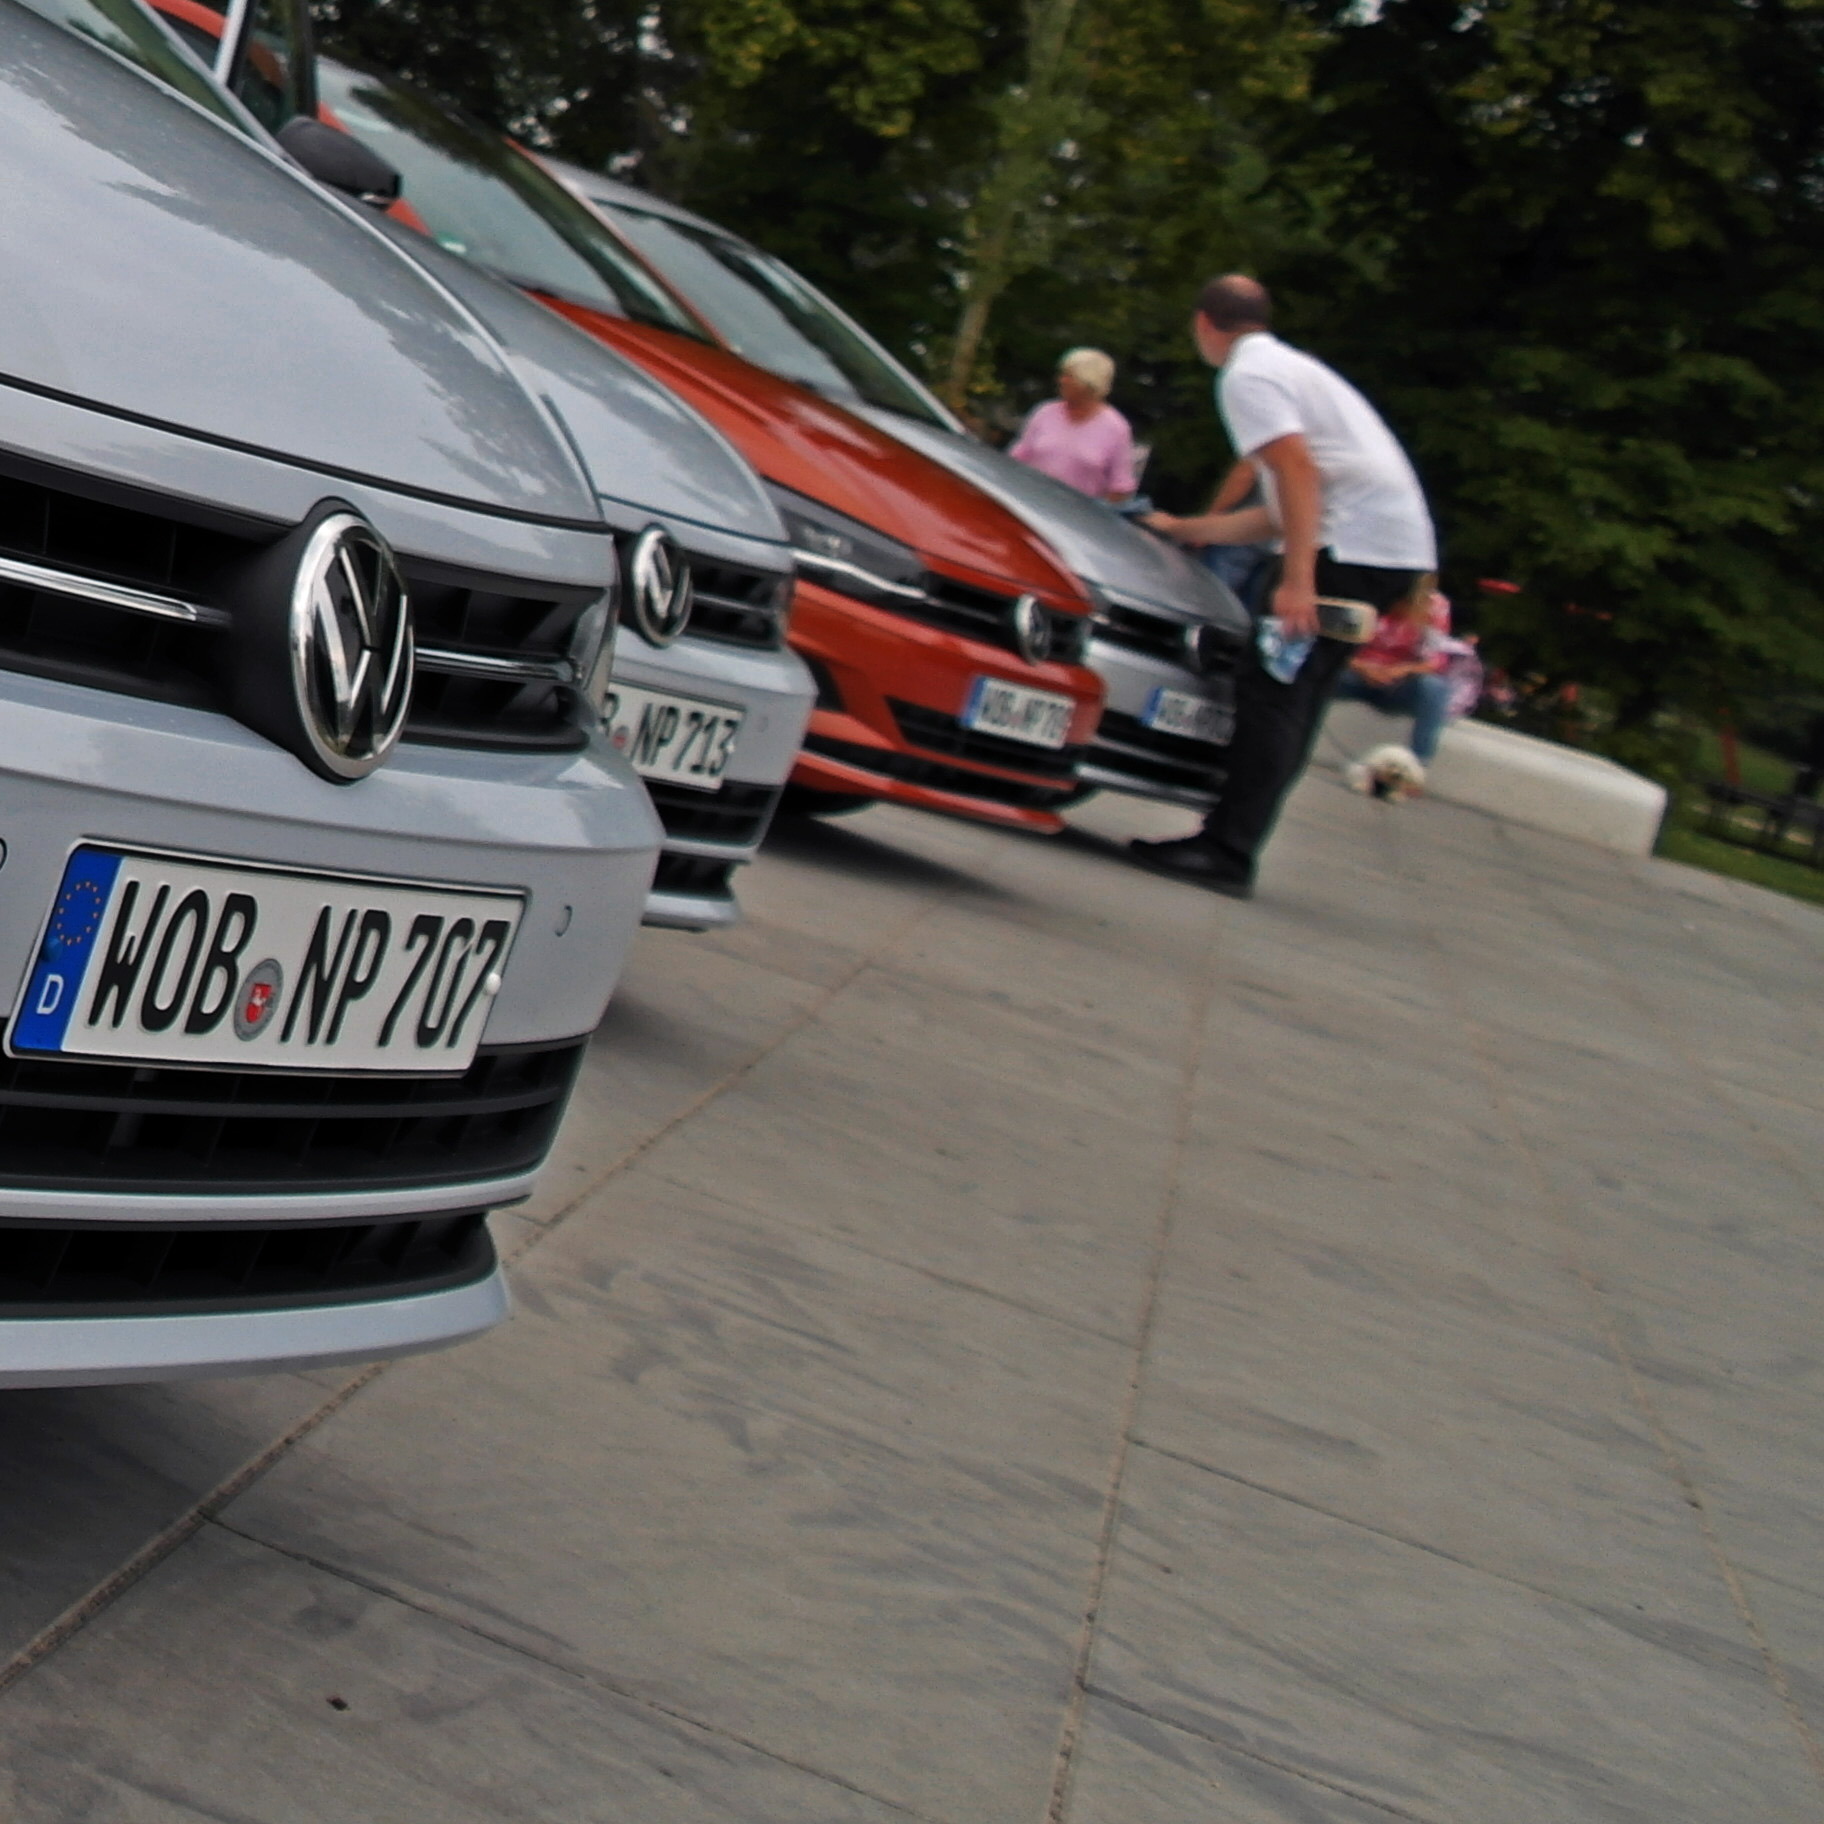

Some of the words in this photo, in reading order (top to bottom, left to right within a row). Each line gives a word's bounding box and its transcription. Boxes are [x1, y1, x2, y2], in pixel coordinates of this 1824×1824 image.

[630, 703, 681, 766] NP
[672, 712, 739, 778] 713
[37, 974, 64, 1015] D
[88, 880, 257, 1034] WOB
[280, 905, 391, 1045] NP
[378, 914, 510, 1048] 707
